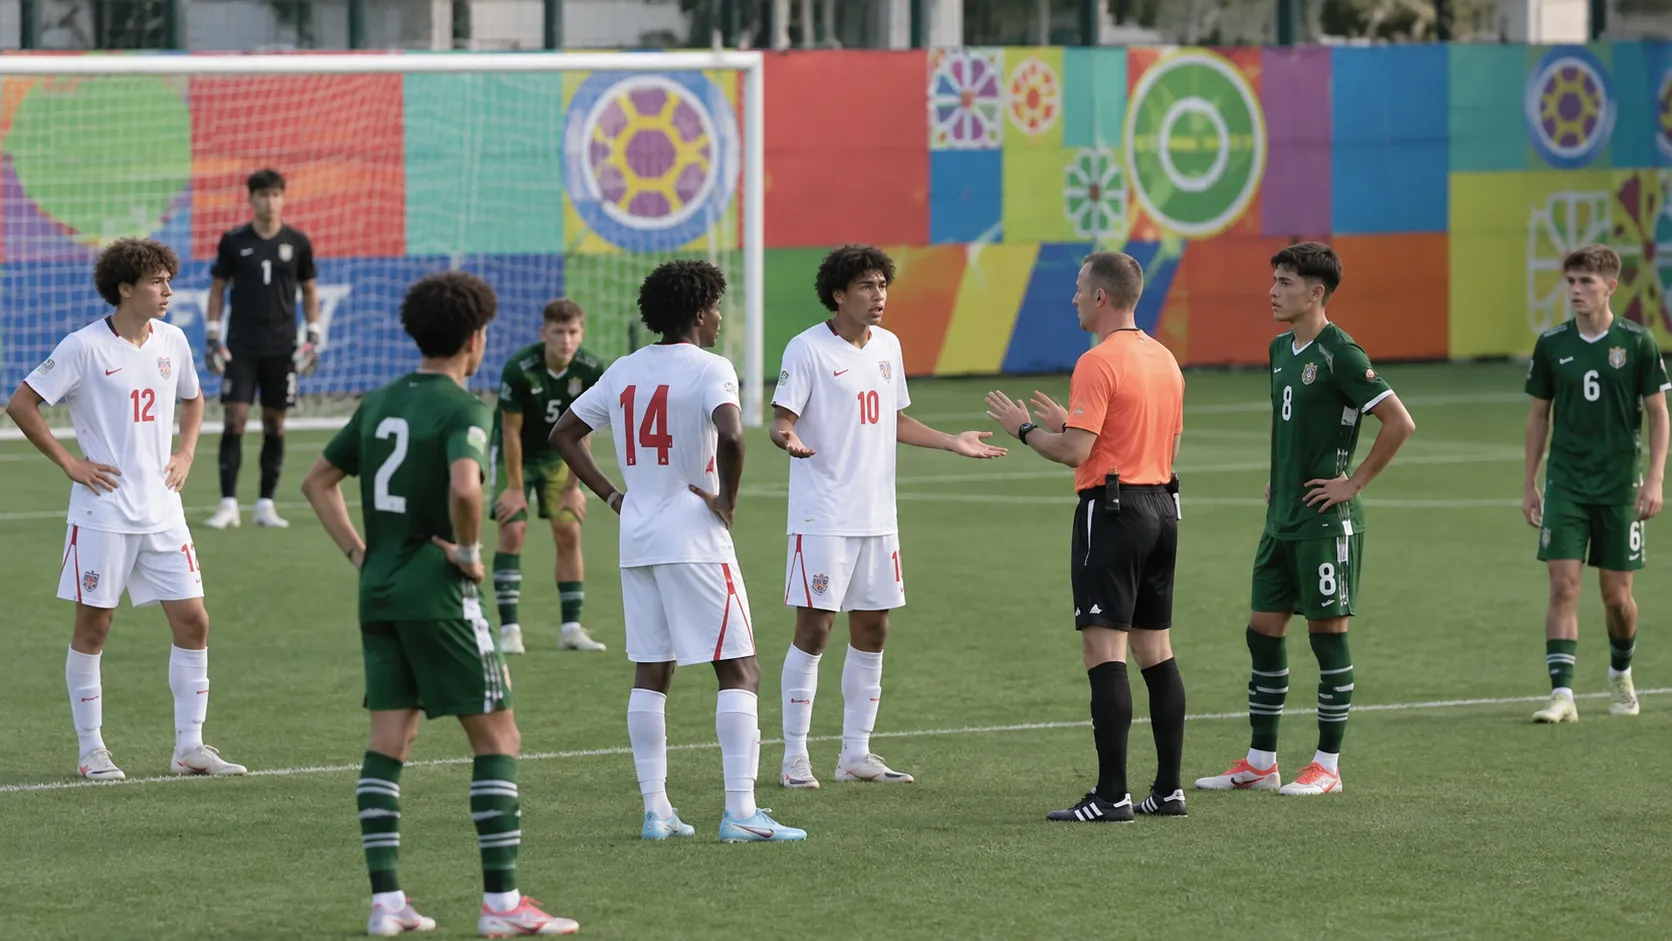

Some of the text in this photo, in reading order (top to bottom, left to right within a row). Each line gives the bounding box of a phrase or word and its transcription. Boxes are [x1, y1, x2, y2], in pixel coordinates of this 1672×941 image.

[261, 260, 272, 285] 1
[1583, 370, 1600, 401] 6
[130, 388, 155, 422] 12
[545, 400, 561, 423] 5
[857, 390, 879, 425] 10
[1281, 385, 1292, 421] 8
[620, 385, 673, 466] 14
[374, 417, 409, 513] 2
[1629, 521, 1641, 551] 6
[1318, 562, 1336, 596] 8
